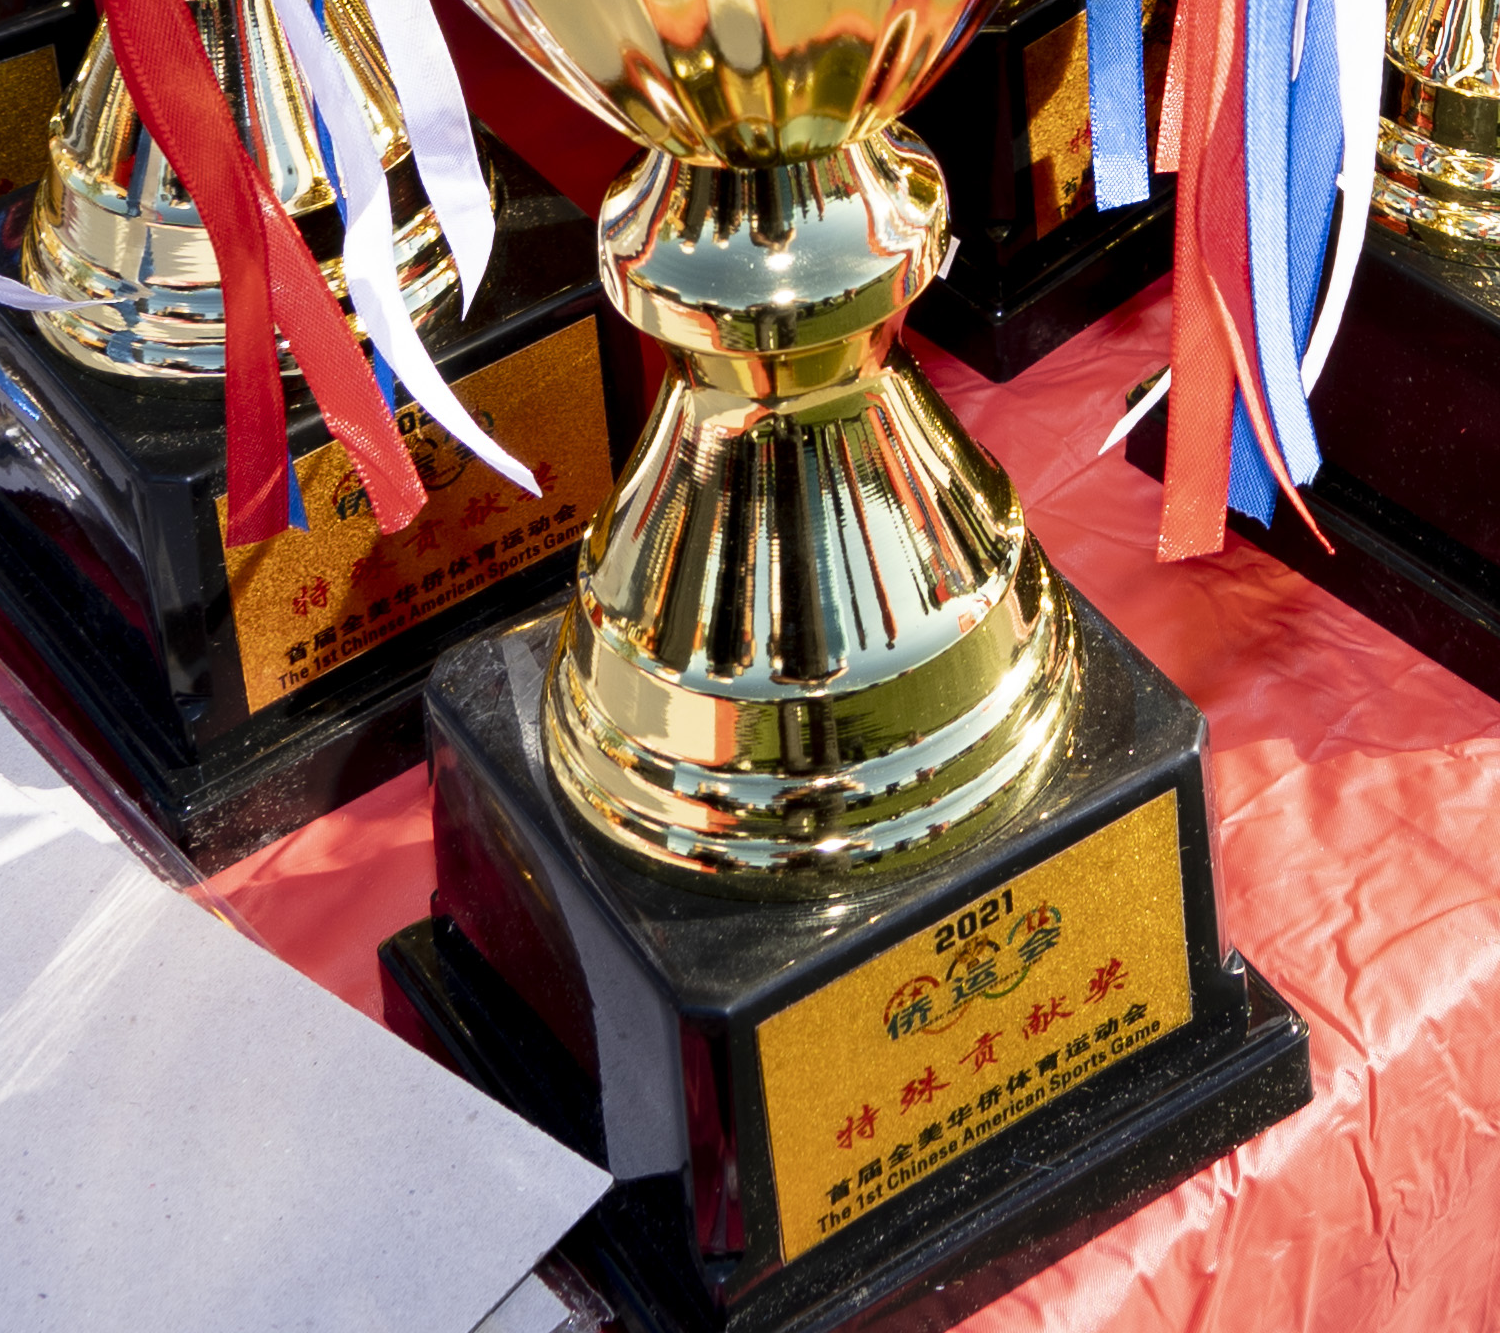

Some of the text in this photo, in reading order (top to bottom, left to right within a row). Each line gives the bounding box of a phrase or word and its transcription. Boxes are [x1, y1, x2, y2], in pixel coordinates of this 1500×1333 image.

[278, 519, 590, 690] The 1st Chinese American Sports Game
[887, 926, 1061, 1041] 侨运会
[934, 888, 1014, 955] 2021
[817, 1018, 1162, 1235] The 1st Chinese American Sports Game
[825, 1003, 1148, 1205] 首届全美华侨体育运动会
[836, 958, 1129, 1150] 特殊贡献奖
